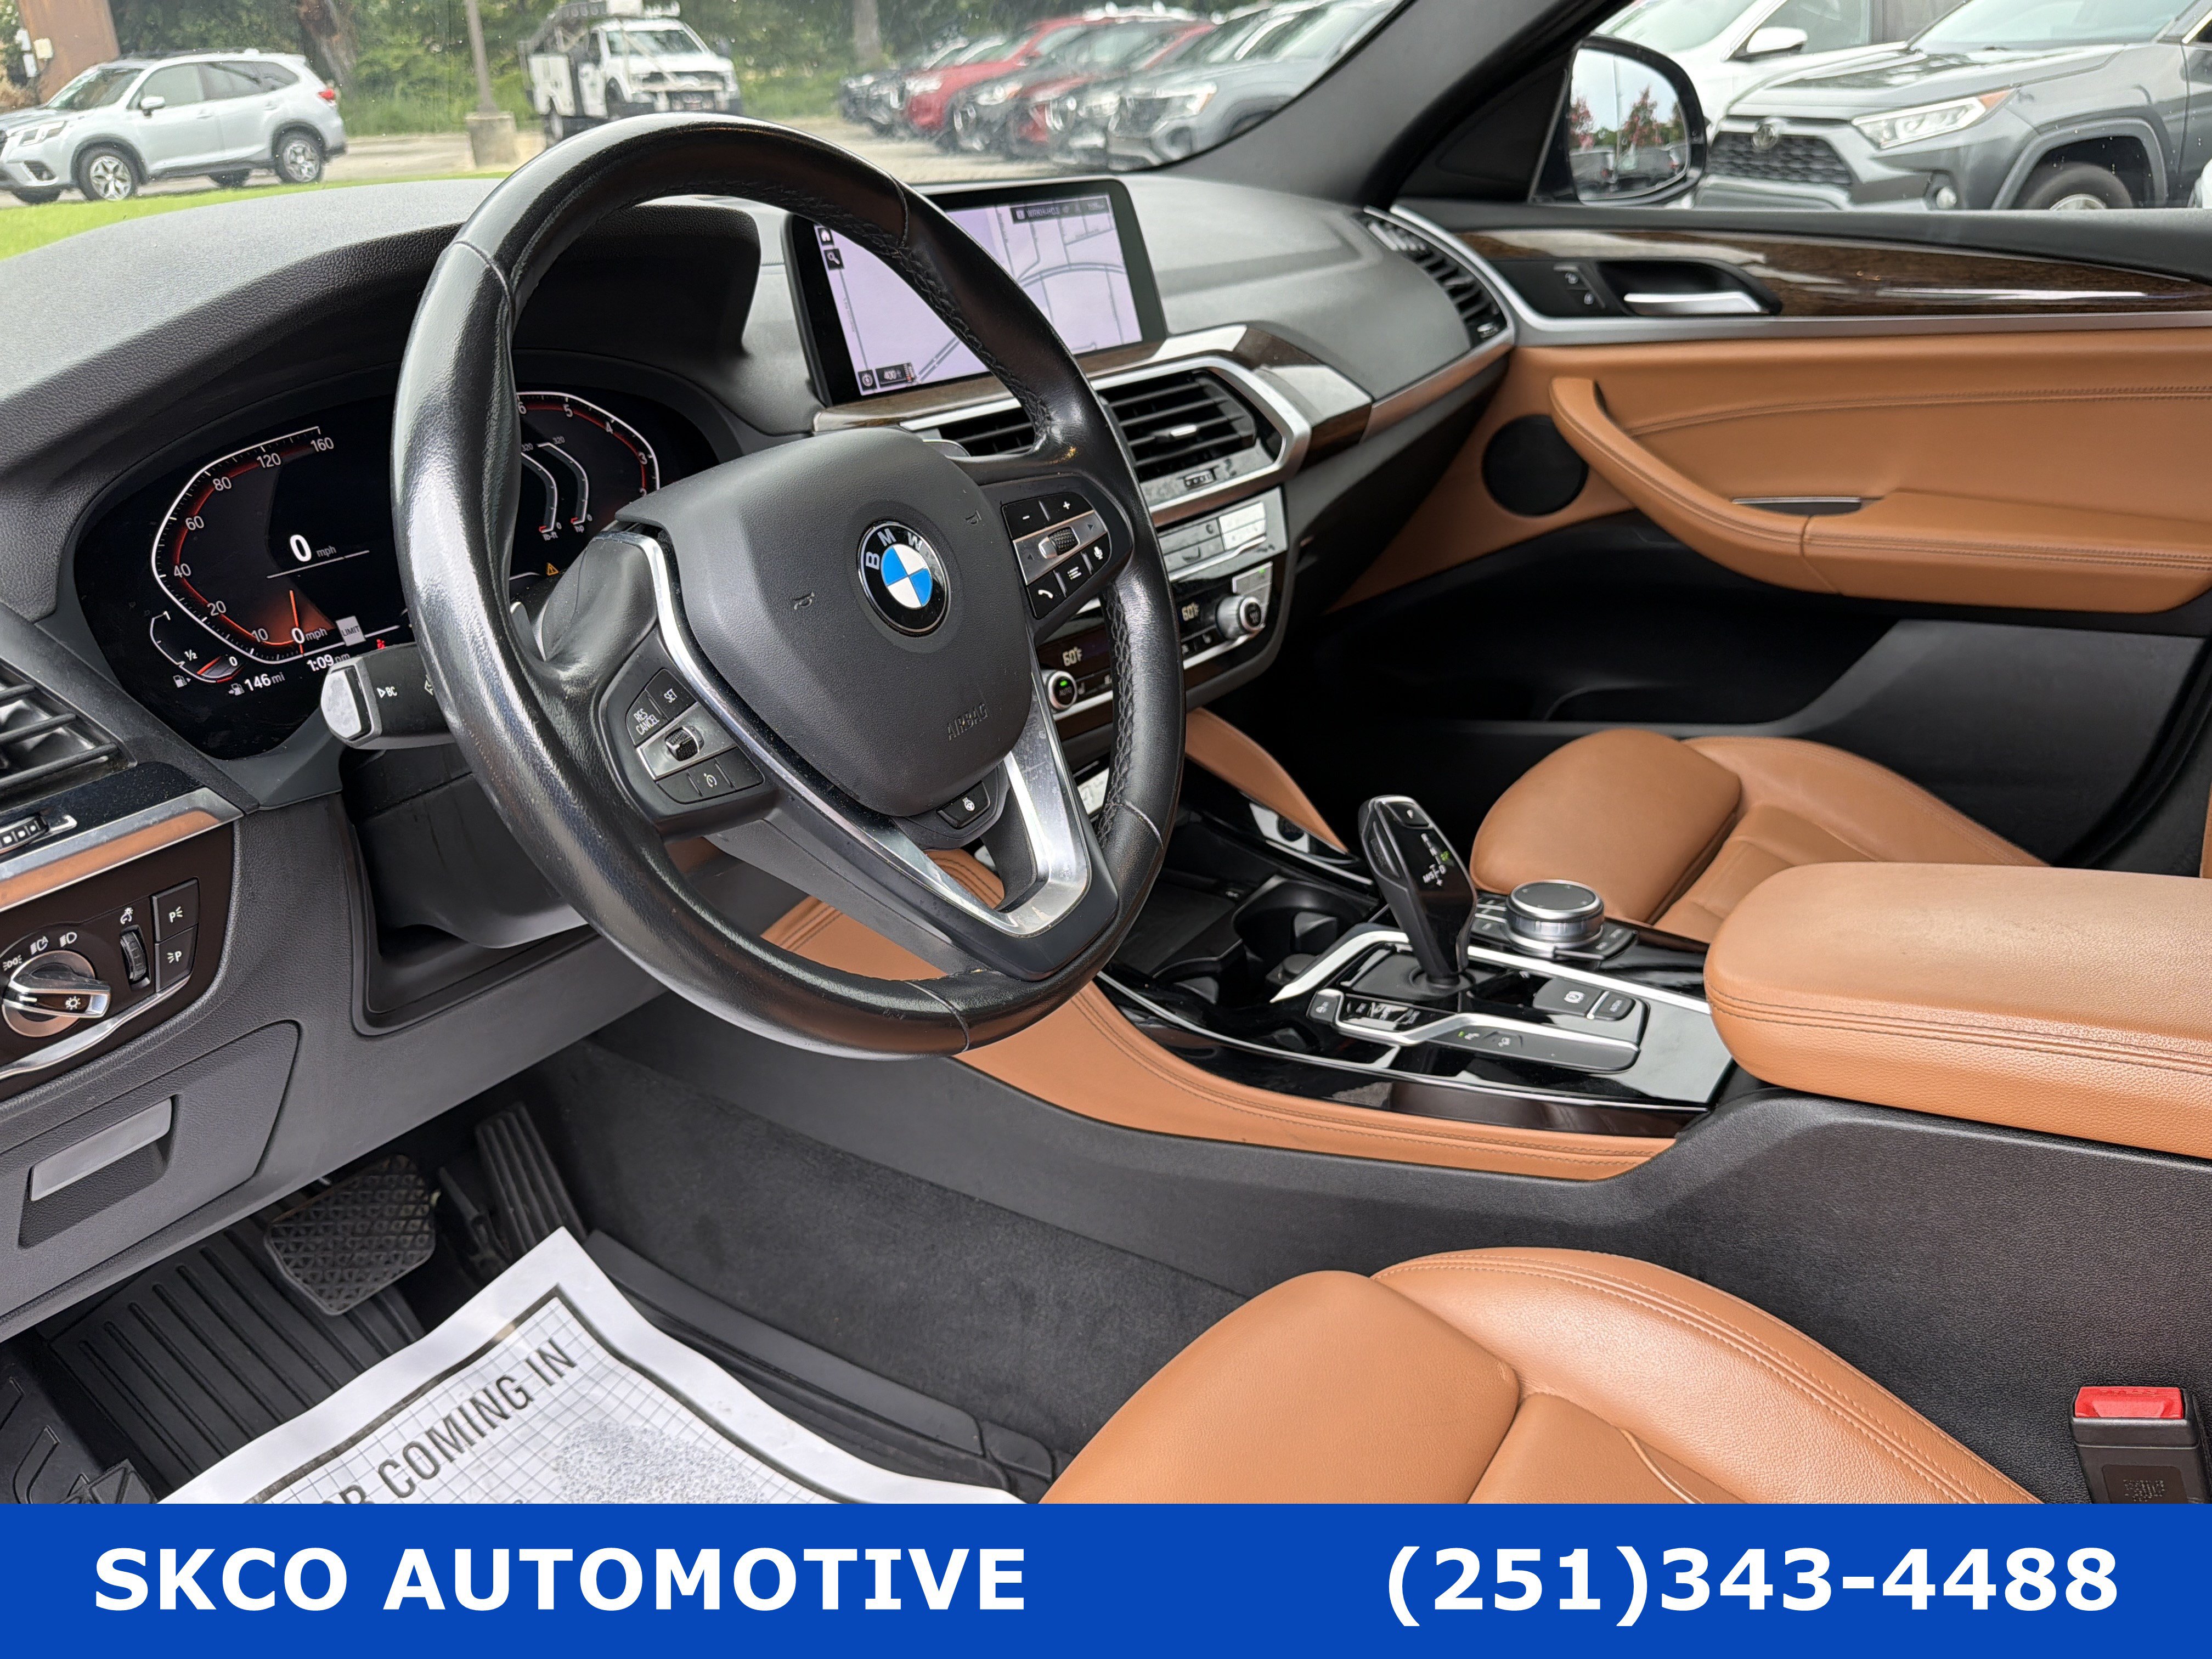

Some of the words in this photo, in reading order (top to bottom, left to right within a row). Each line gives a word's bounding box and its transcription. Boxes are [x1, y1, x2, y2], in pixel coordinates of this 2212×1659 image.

[518, 402, 527, 415] 6
[563, 404, 573, 418] 5
[605, 421, 614, 434] 4
[310, 437, 334, 453] 160
[256, 453, 281, 469] 120
[638, 452, 647, 465] 3
[212, 477, 232, 492] 80
[185, 516, 205, 531] 60
[290, 534, 312, 562] 0
[316, 545, 337, 557] mph
[866, 528, 923, 569] BMW
[173, 563, 191, 578] 40
[207, 601, 227, 616] 20
[252, 628, 269, 642] 10
[291, 627, 305, 644] 0
[306, 627, 328, 641] mph
[341, 625, 360, 636] LIMIT
[229, 656, 238, 667] 0
[306, 654, 334, 672] 1:09
[244, 673, 271, 691] 146
[271, 672, 285, 684] mi
[385, 686, 398, 697] BC
[664, 689, 678, 703] SET
[634, 708, 648, 722] RES
[947, 703, 988, 741] AIRBAG
[636, 714, 660, 736] CANCEL
[378, 1374, 535, 1498] COMING
[524, 1338, 577, 1387] IN
